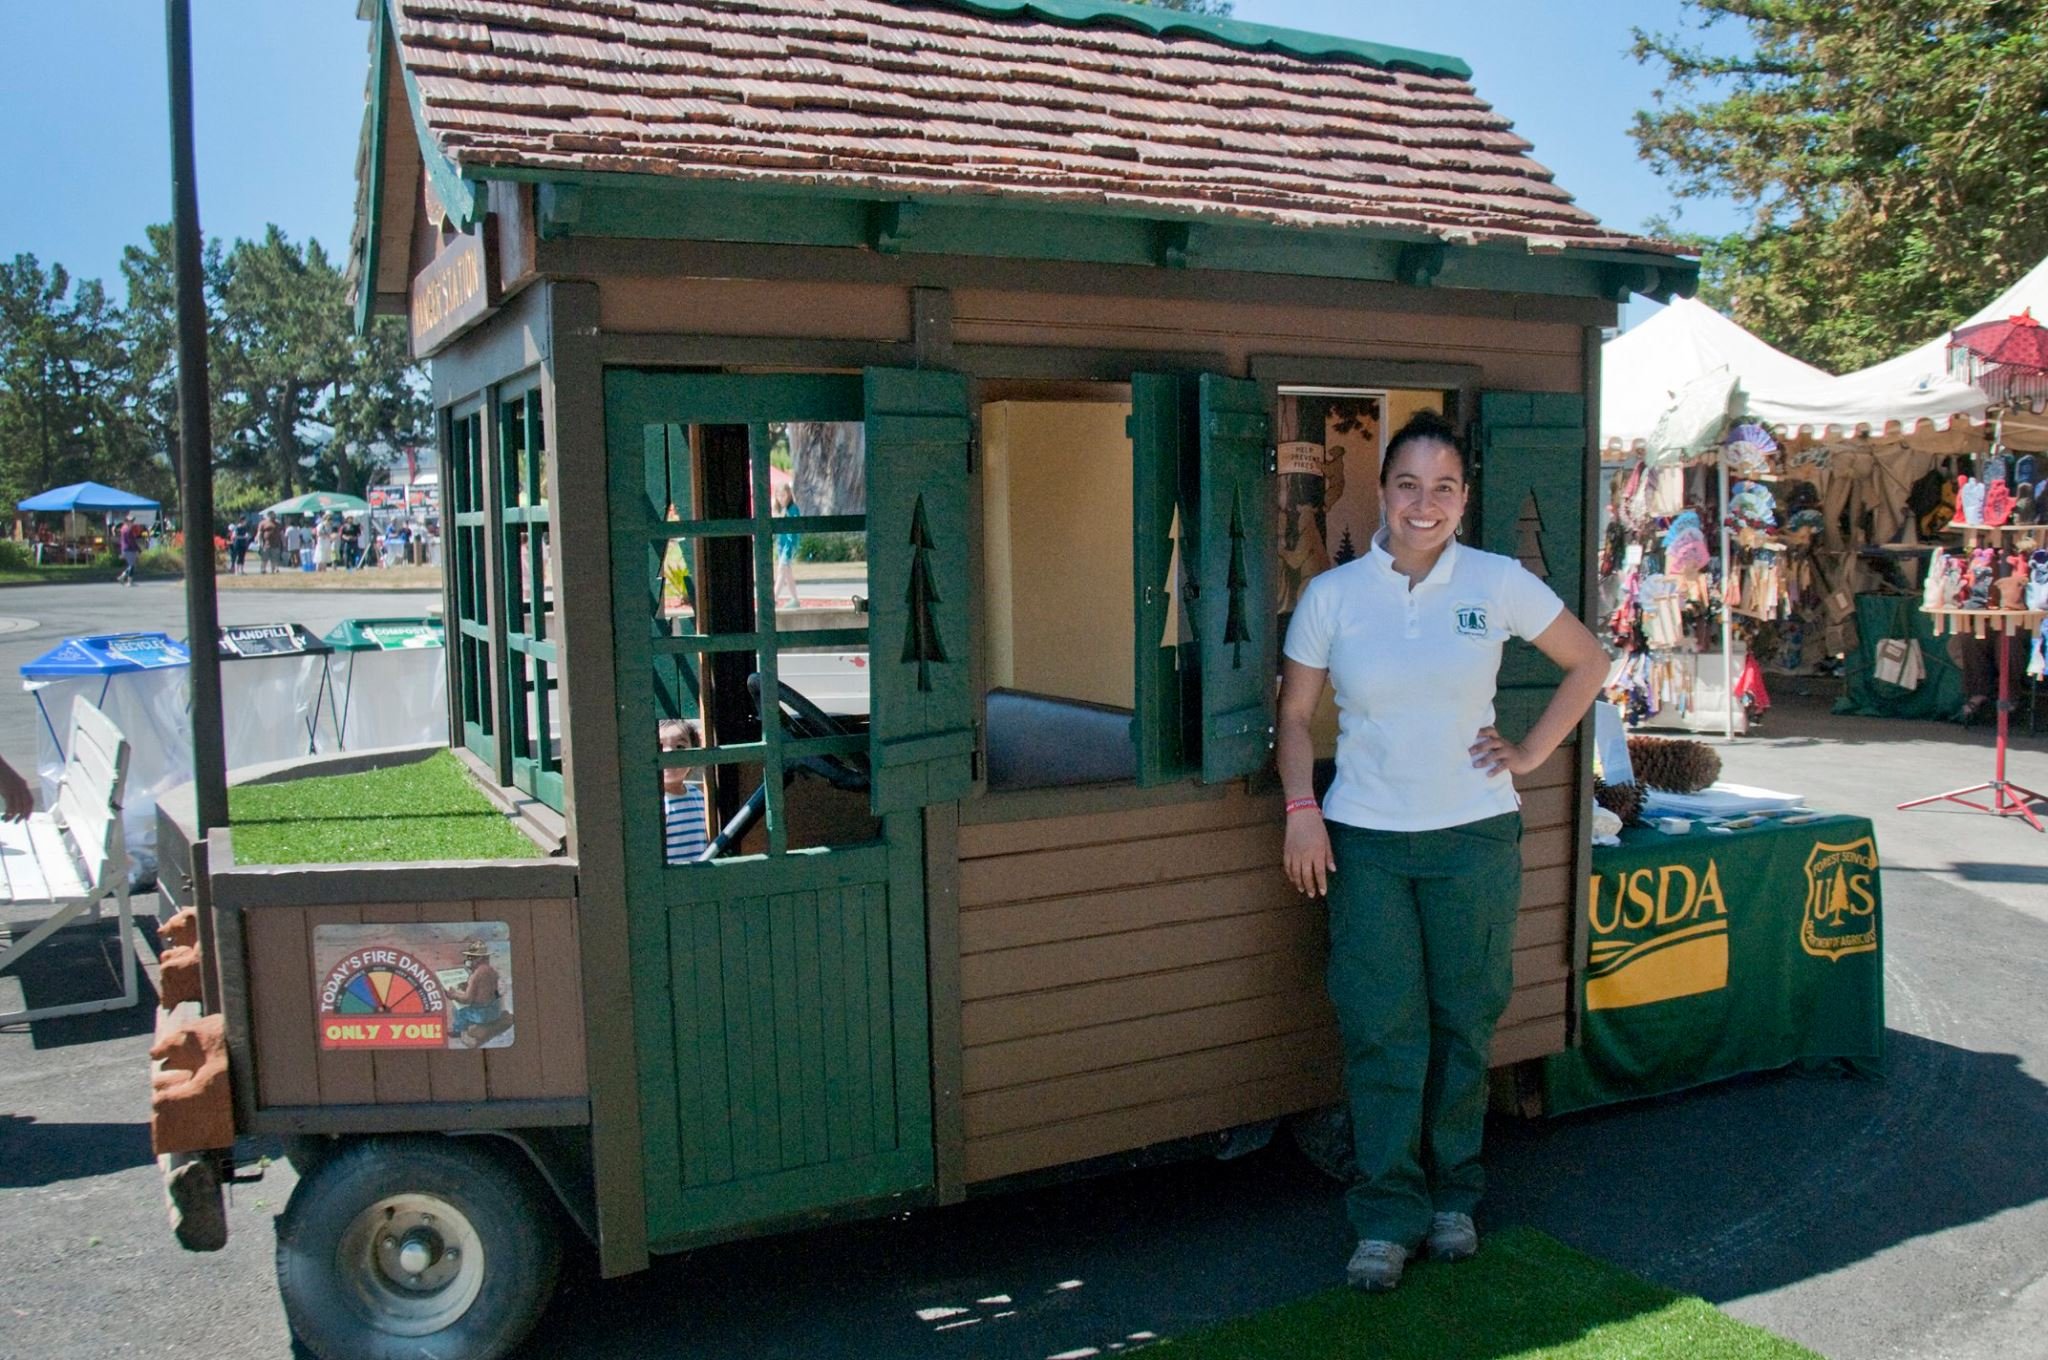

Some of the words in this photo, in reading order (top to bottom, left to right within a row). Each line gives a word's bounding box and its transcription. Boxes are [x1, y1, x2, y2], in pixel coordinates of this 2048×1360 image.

[441, 246, 480, 317] STATION
[230, 628, 288, 641] LANDFILL
[1813, 852, 1841, 877] FOREST
[1589, 858, 1728, 934] USDA
[321, 956, 361, 1012] TODAY'S
[362, 950, 398, 965] FIRE
[398, 955, 443, 1012] DANGER
[326, 1025, 380, 1040] ONLY
[389, 1024, 443, 1039] YOU!
